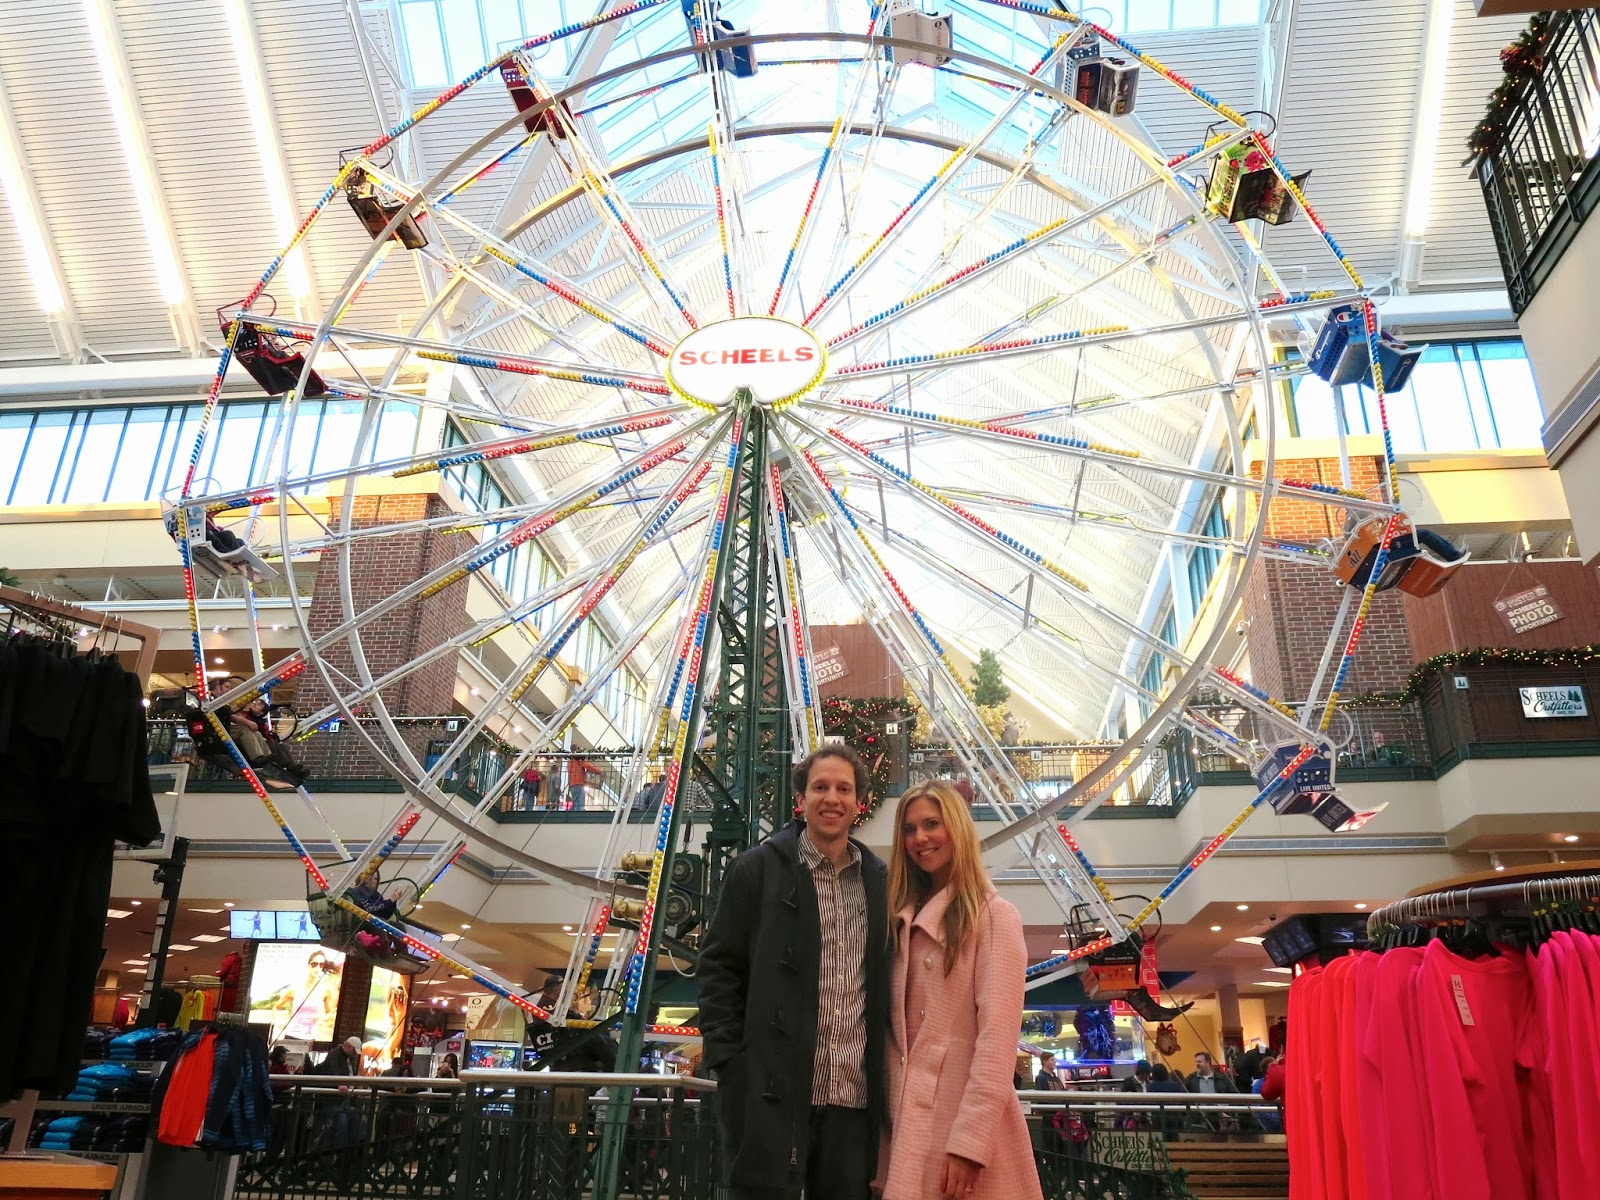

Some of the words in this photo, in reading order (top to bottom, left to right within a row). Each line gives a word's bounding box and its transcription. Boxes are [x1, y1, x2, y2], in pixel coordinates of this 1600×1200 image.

[679, 347, 814, 365] SCHEELS
[1507, 592, 1535, 609] POSTED
[1507, 599, 1546, 617] SCHEELS
[1509, 605, 1554, 628] PHOTO
[1515, 614, 1558, 634] OPPORTUNITY
[816, 671, 844, 685] ORTUNITY
[1522, 690, 1566, 705] SCHEELS
[1533, 700, 1582, 714] Outfitters
